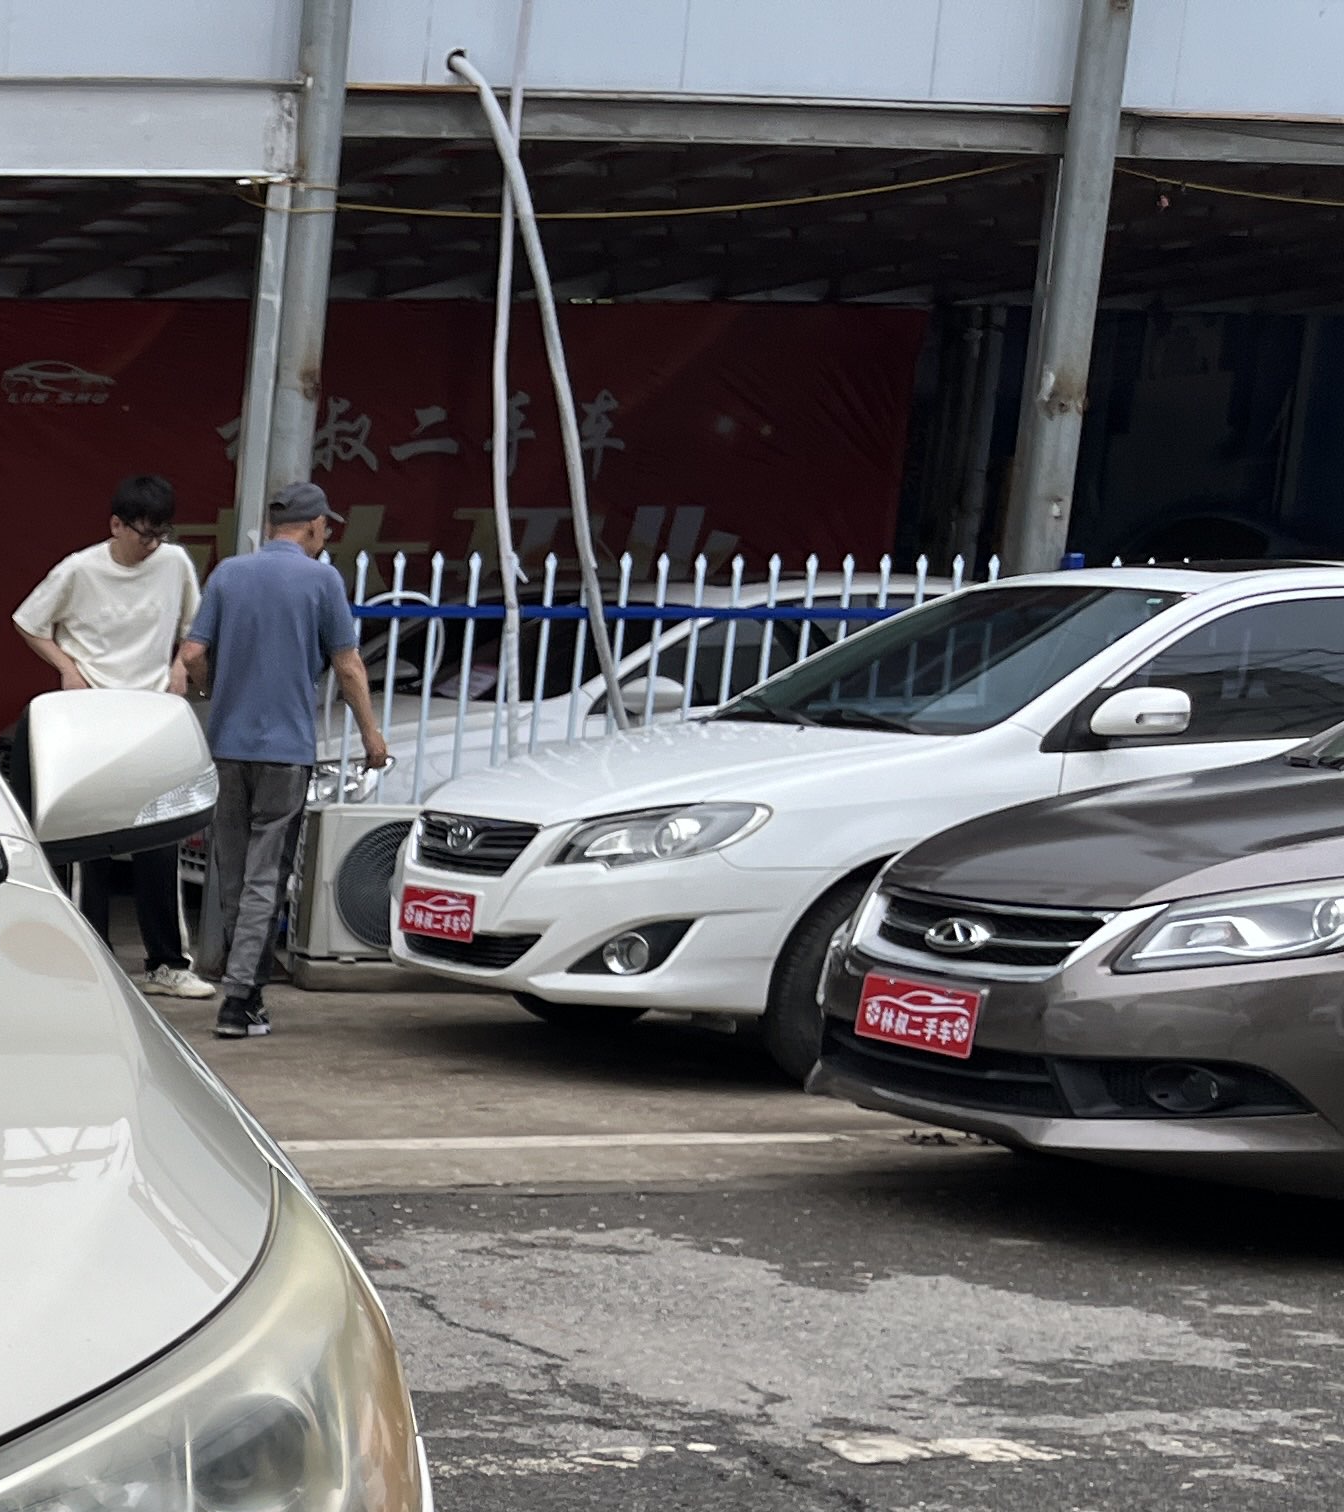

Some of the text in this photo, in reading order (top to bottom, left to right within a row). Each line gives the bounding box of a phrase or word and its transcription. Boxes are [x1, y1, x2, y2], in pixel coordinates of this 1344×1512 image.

[880, 1007, 954, 1045] 林叔二手车
